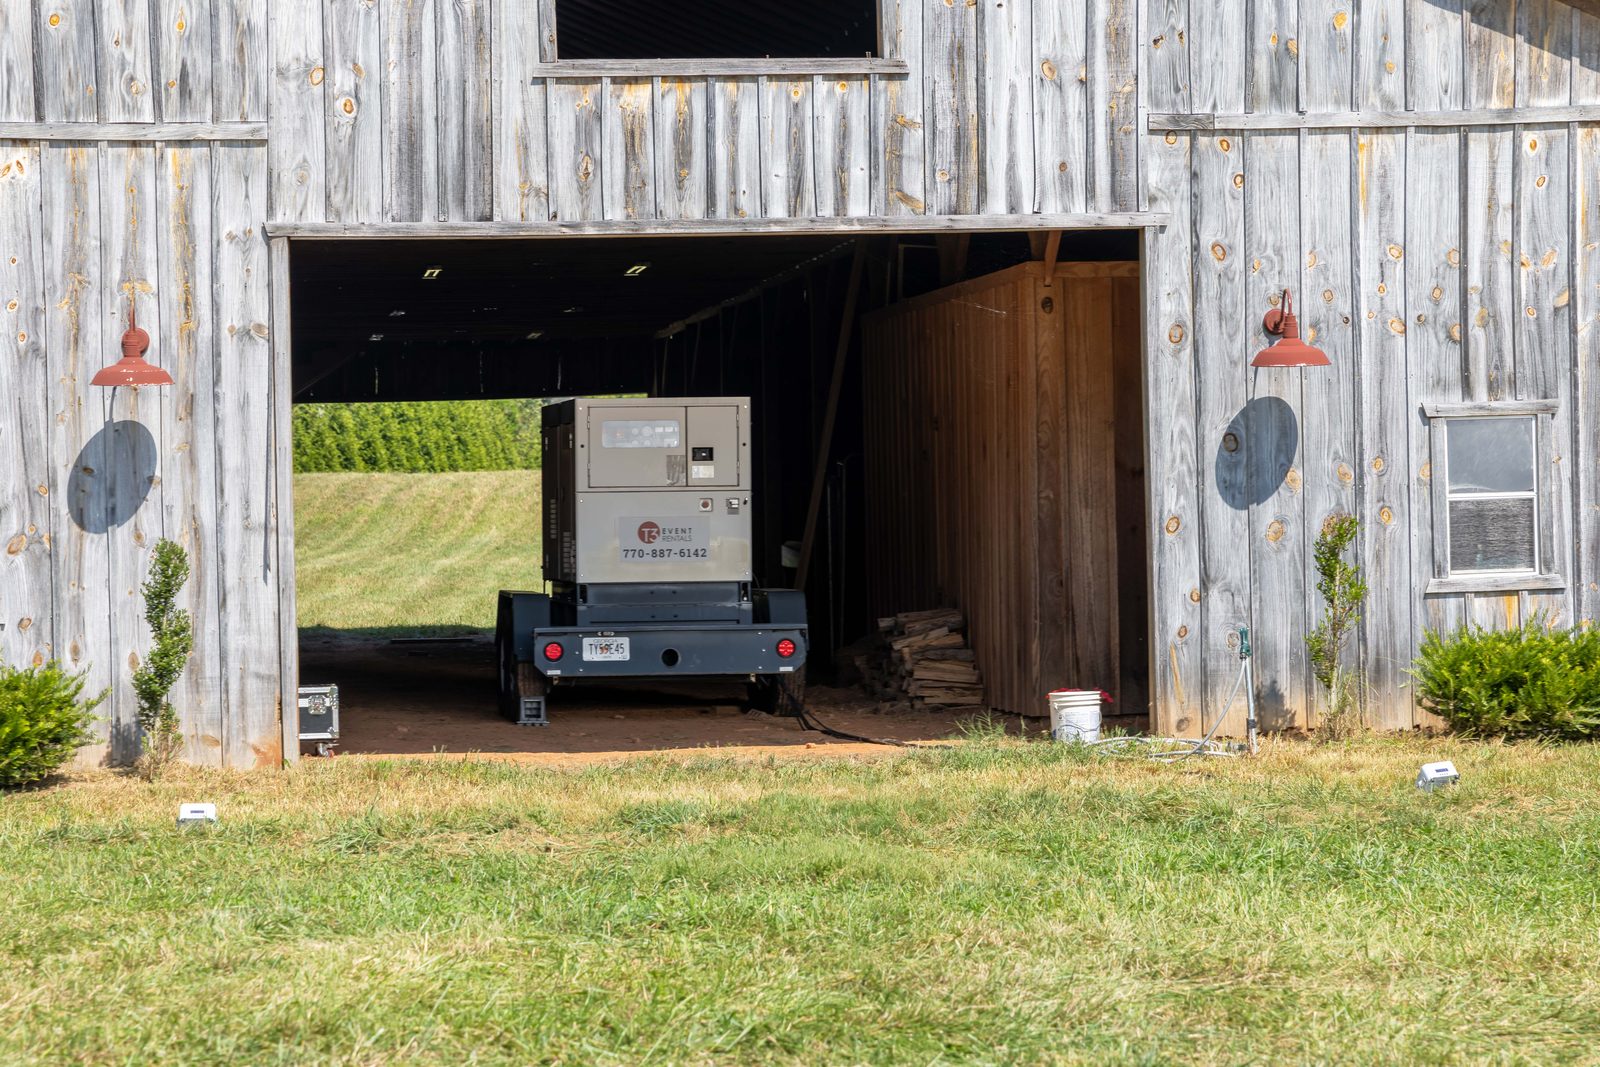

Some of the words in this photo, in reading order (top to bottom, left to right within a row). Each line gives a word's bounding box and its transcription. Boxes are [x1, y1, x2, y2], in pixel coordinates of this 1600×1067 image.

[641, 528, 659, 542] T3
[661, 527, 693, 535] EVENT
[623, 548, 708, 558] 770-887-6142
